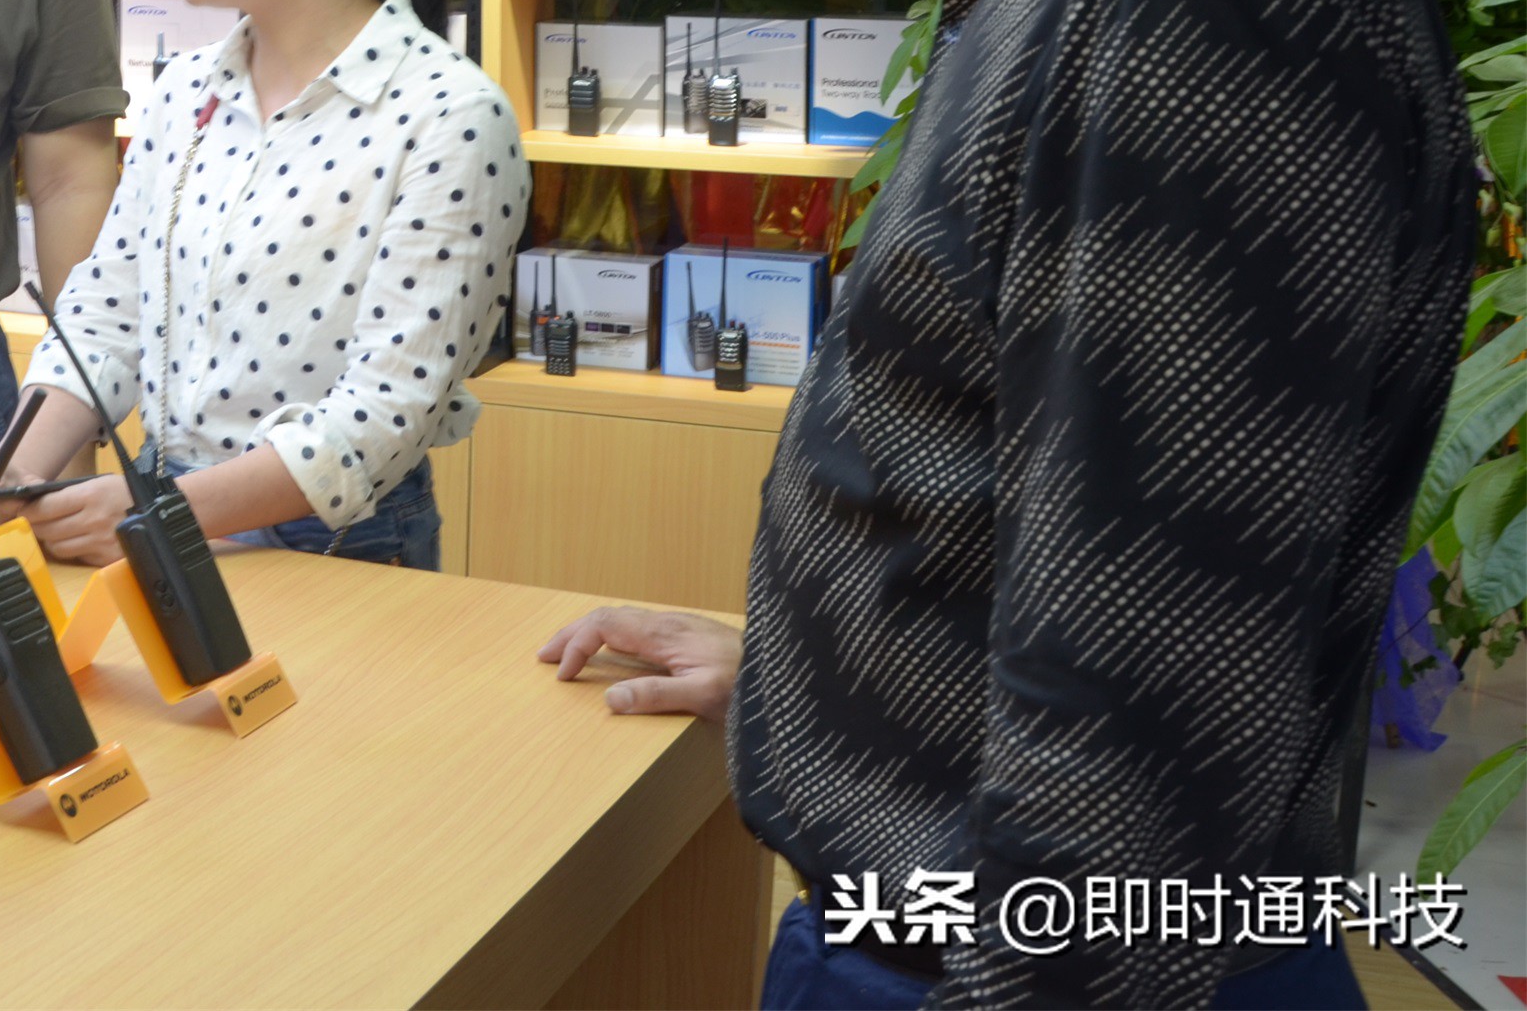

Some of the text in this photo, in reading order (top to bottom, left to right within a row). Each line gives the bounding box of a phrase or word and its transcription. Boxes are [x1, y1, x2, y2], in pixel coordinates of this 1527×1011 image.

[747, 28, 797, 39] LINTON
[823, 28, 878, 40] LINTON
[823, 77, 879, 88] Professional
[746, 270, 803, 282] LINTON
